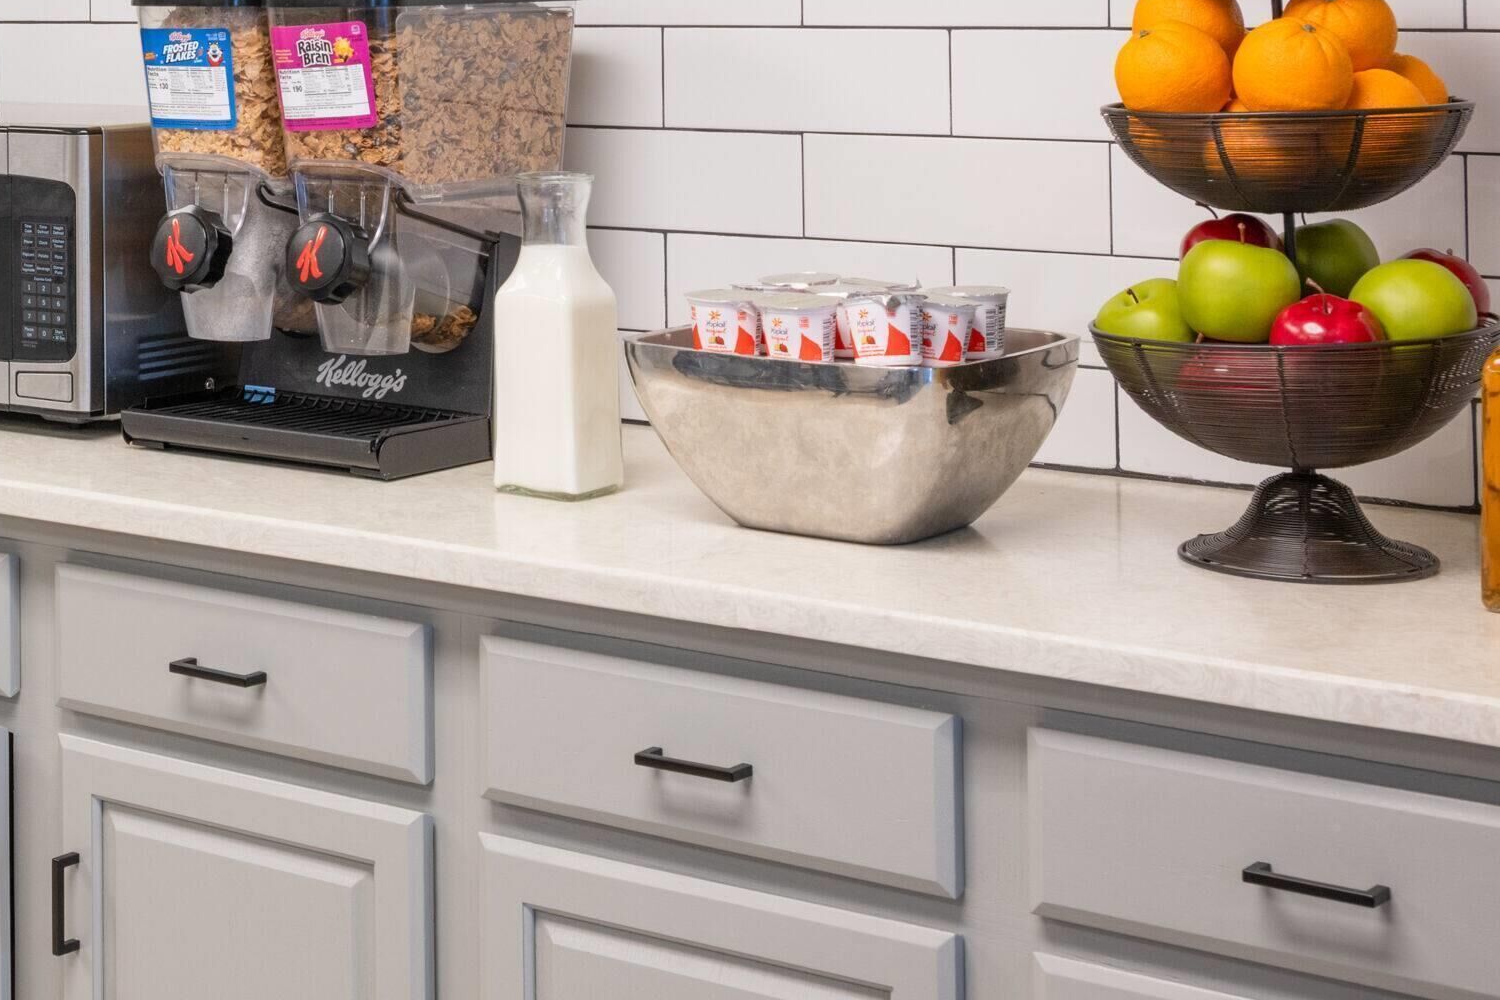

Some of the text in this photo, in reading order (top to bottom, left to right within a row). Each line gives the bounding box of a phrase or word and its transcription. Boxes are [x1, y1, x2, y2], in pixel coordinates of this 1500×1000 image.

[163, 41, 199, 55] FROSTED
[298, 40, 331, 54] Raisin
[166, 50, 196, 63] FLAKES
[304, 52, 330, 66] Bran
[316, 354, 407, 399] Kellogg's
